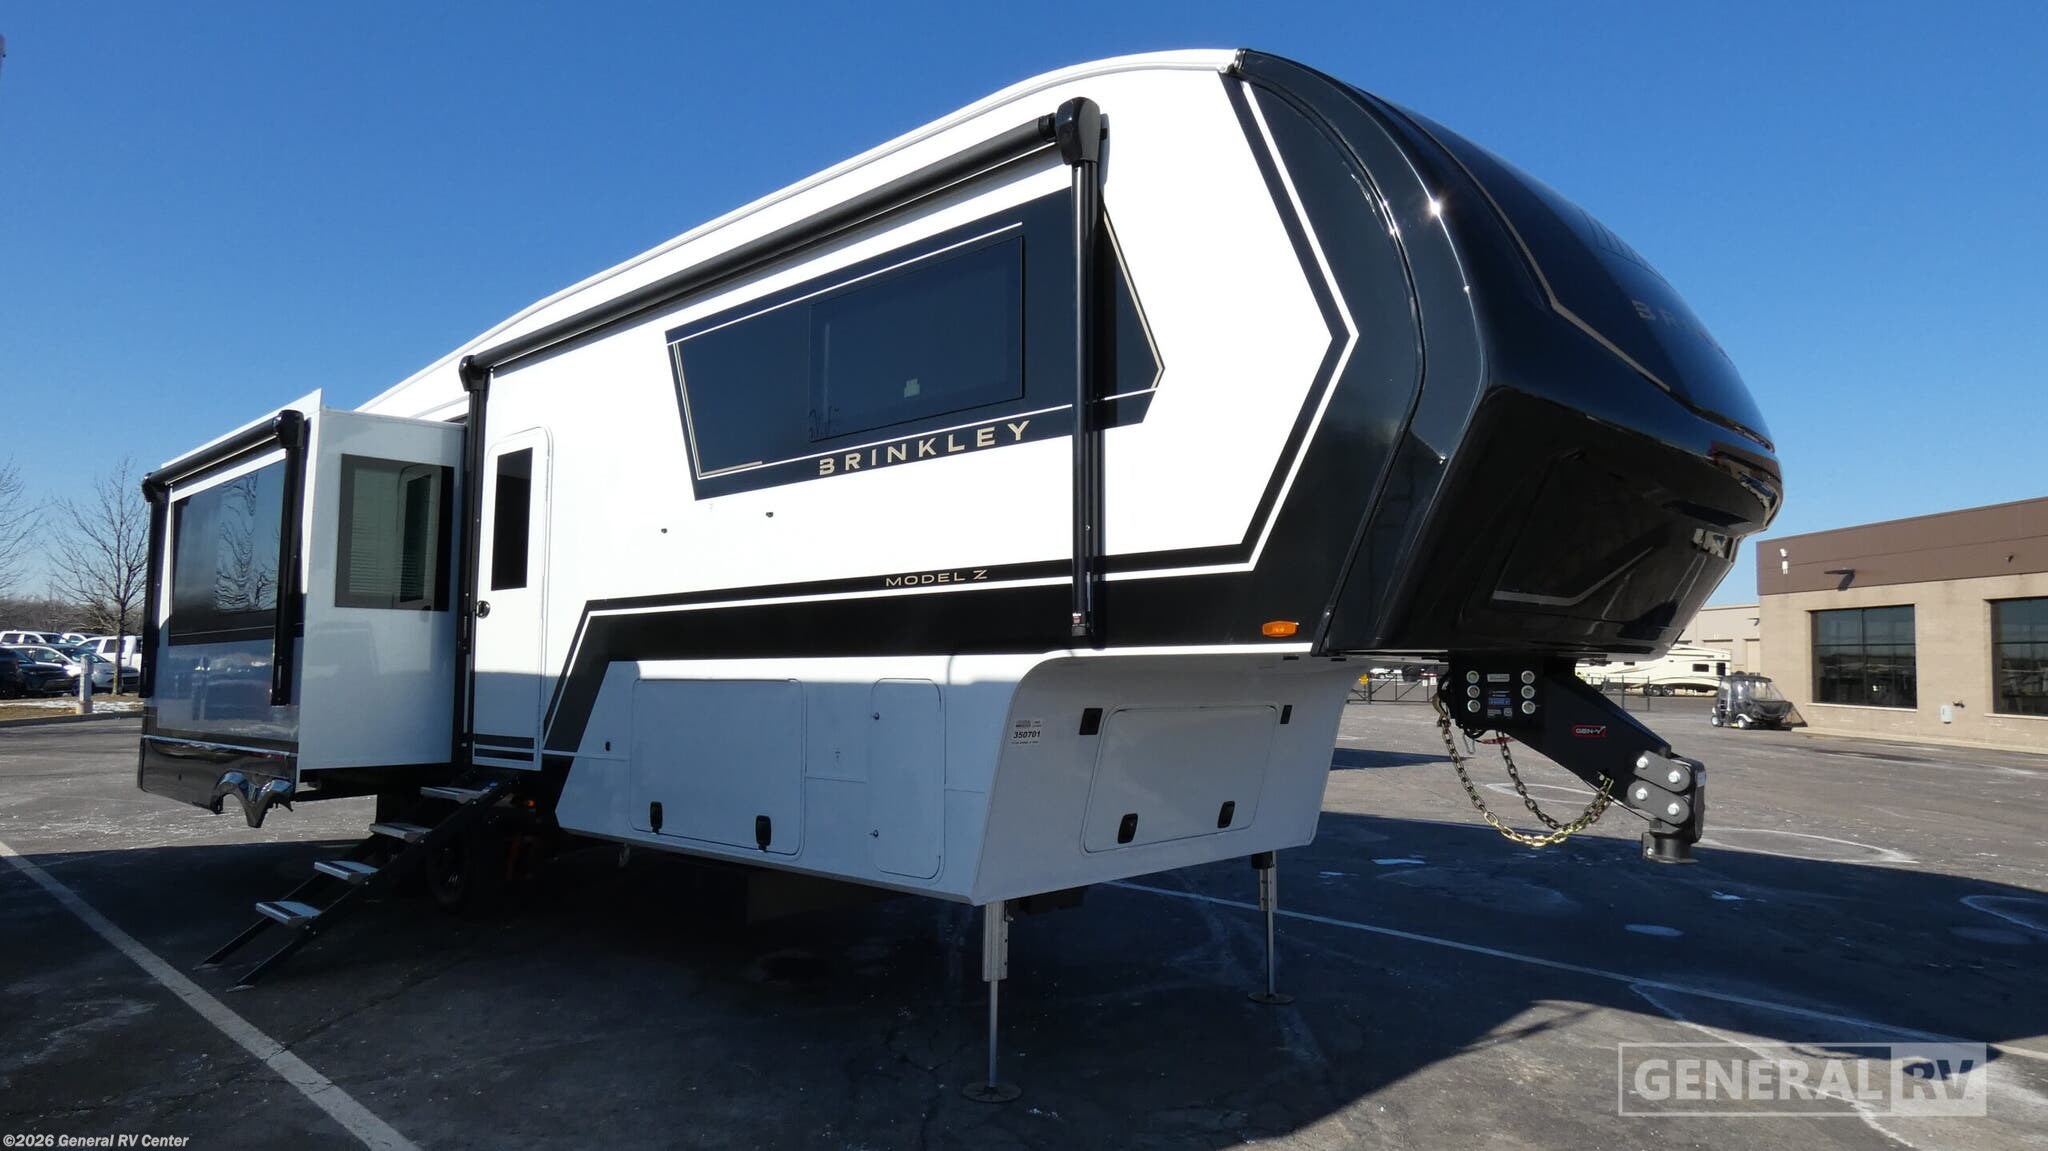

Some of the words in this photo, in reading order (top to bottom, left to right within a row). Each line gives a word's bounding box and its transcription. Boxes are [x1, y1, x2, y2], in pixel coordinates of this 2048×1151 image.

[819, 420, 1030, 476] BRINKLEY
[885, 570, 966, 588] MODEL
[972, 569, 989, 581] Z
[1012, 730, 1041, 740] 350701
